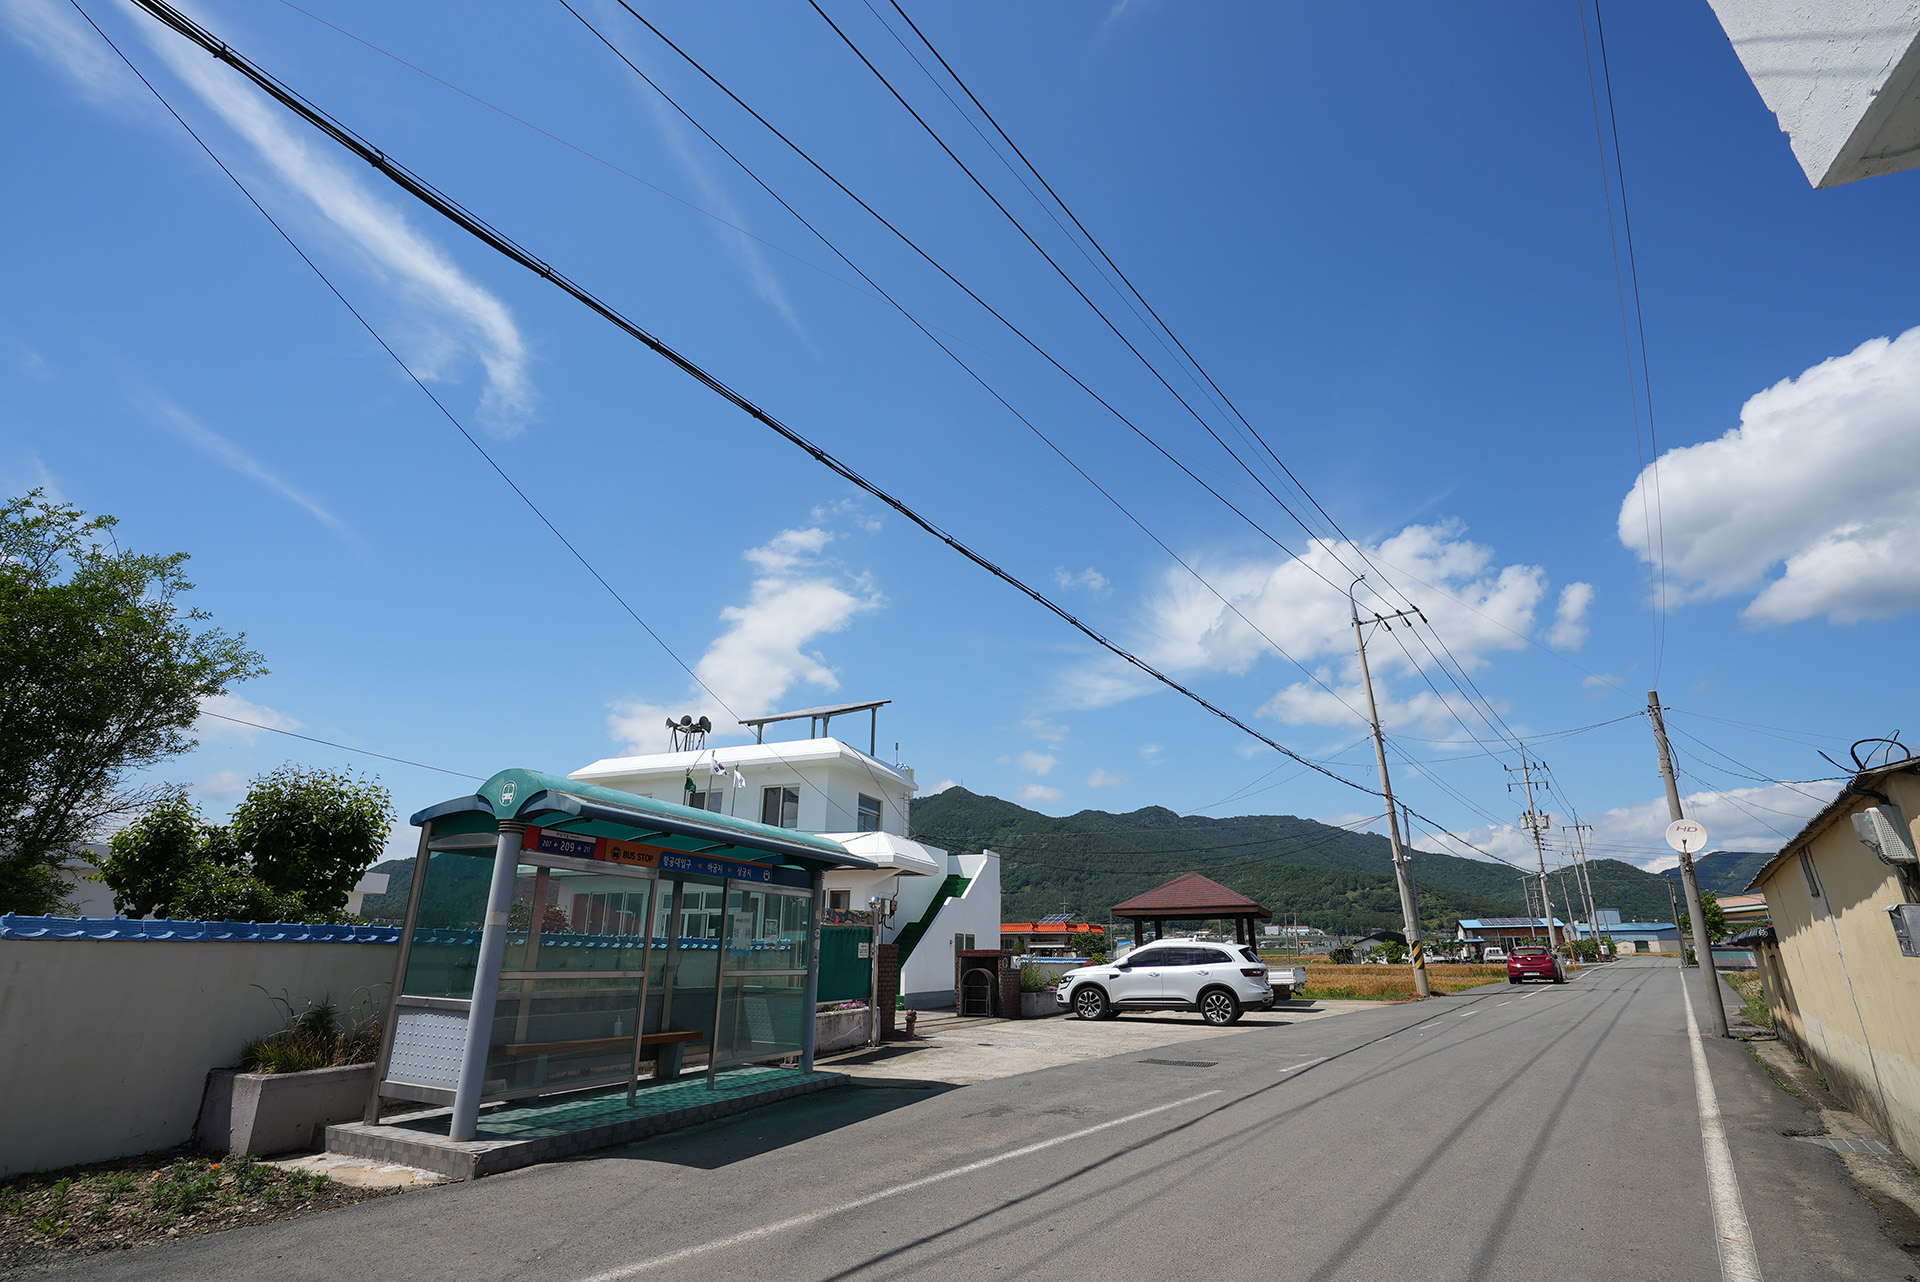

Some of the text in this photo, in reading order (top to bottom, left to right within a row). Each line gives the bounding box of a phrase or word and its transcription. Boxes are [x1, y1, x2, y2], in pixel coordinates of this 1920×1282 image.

[542, 839, 591, 853] 207 209 211
[623, 850, 654, 862] BUS STOP
[663, 855, 692, 869] 항공대입구
[736, 866, 752, 878] 상궁지
